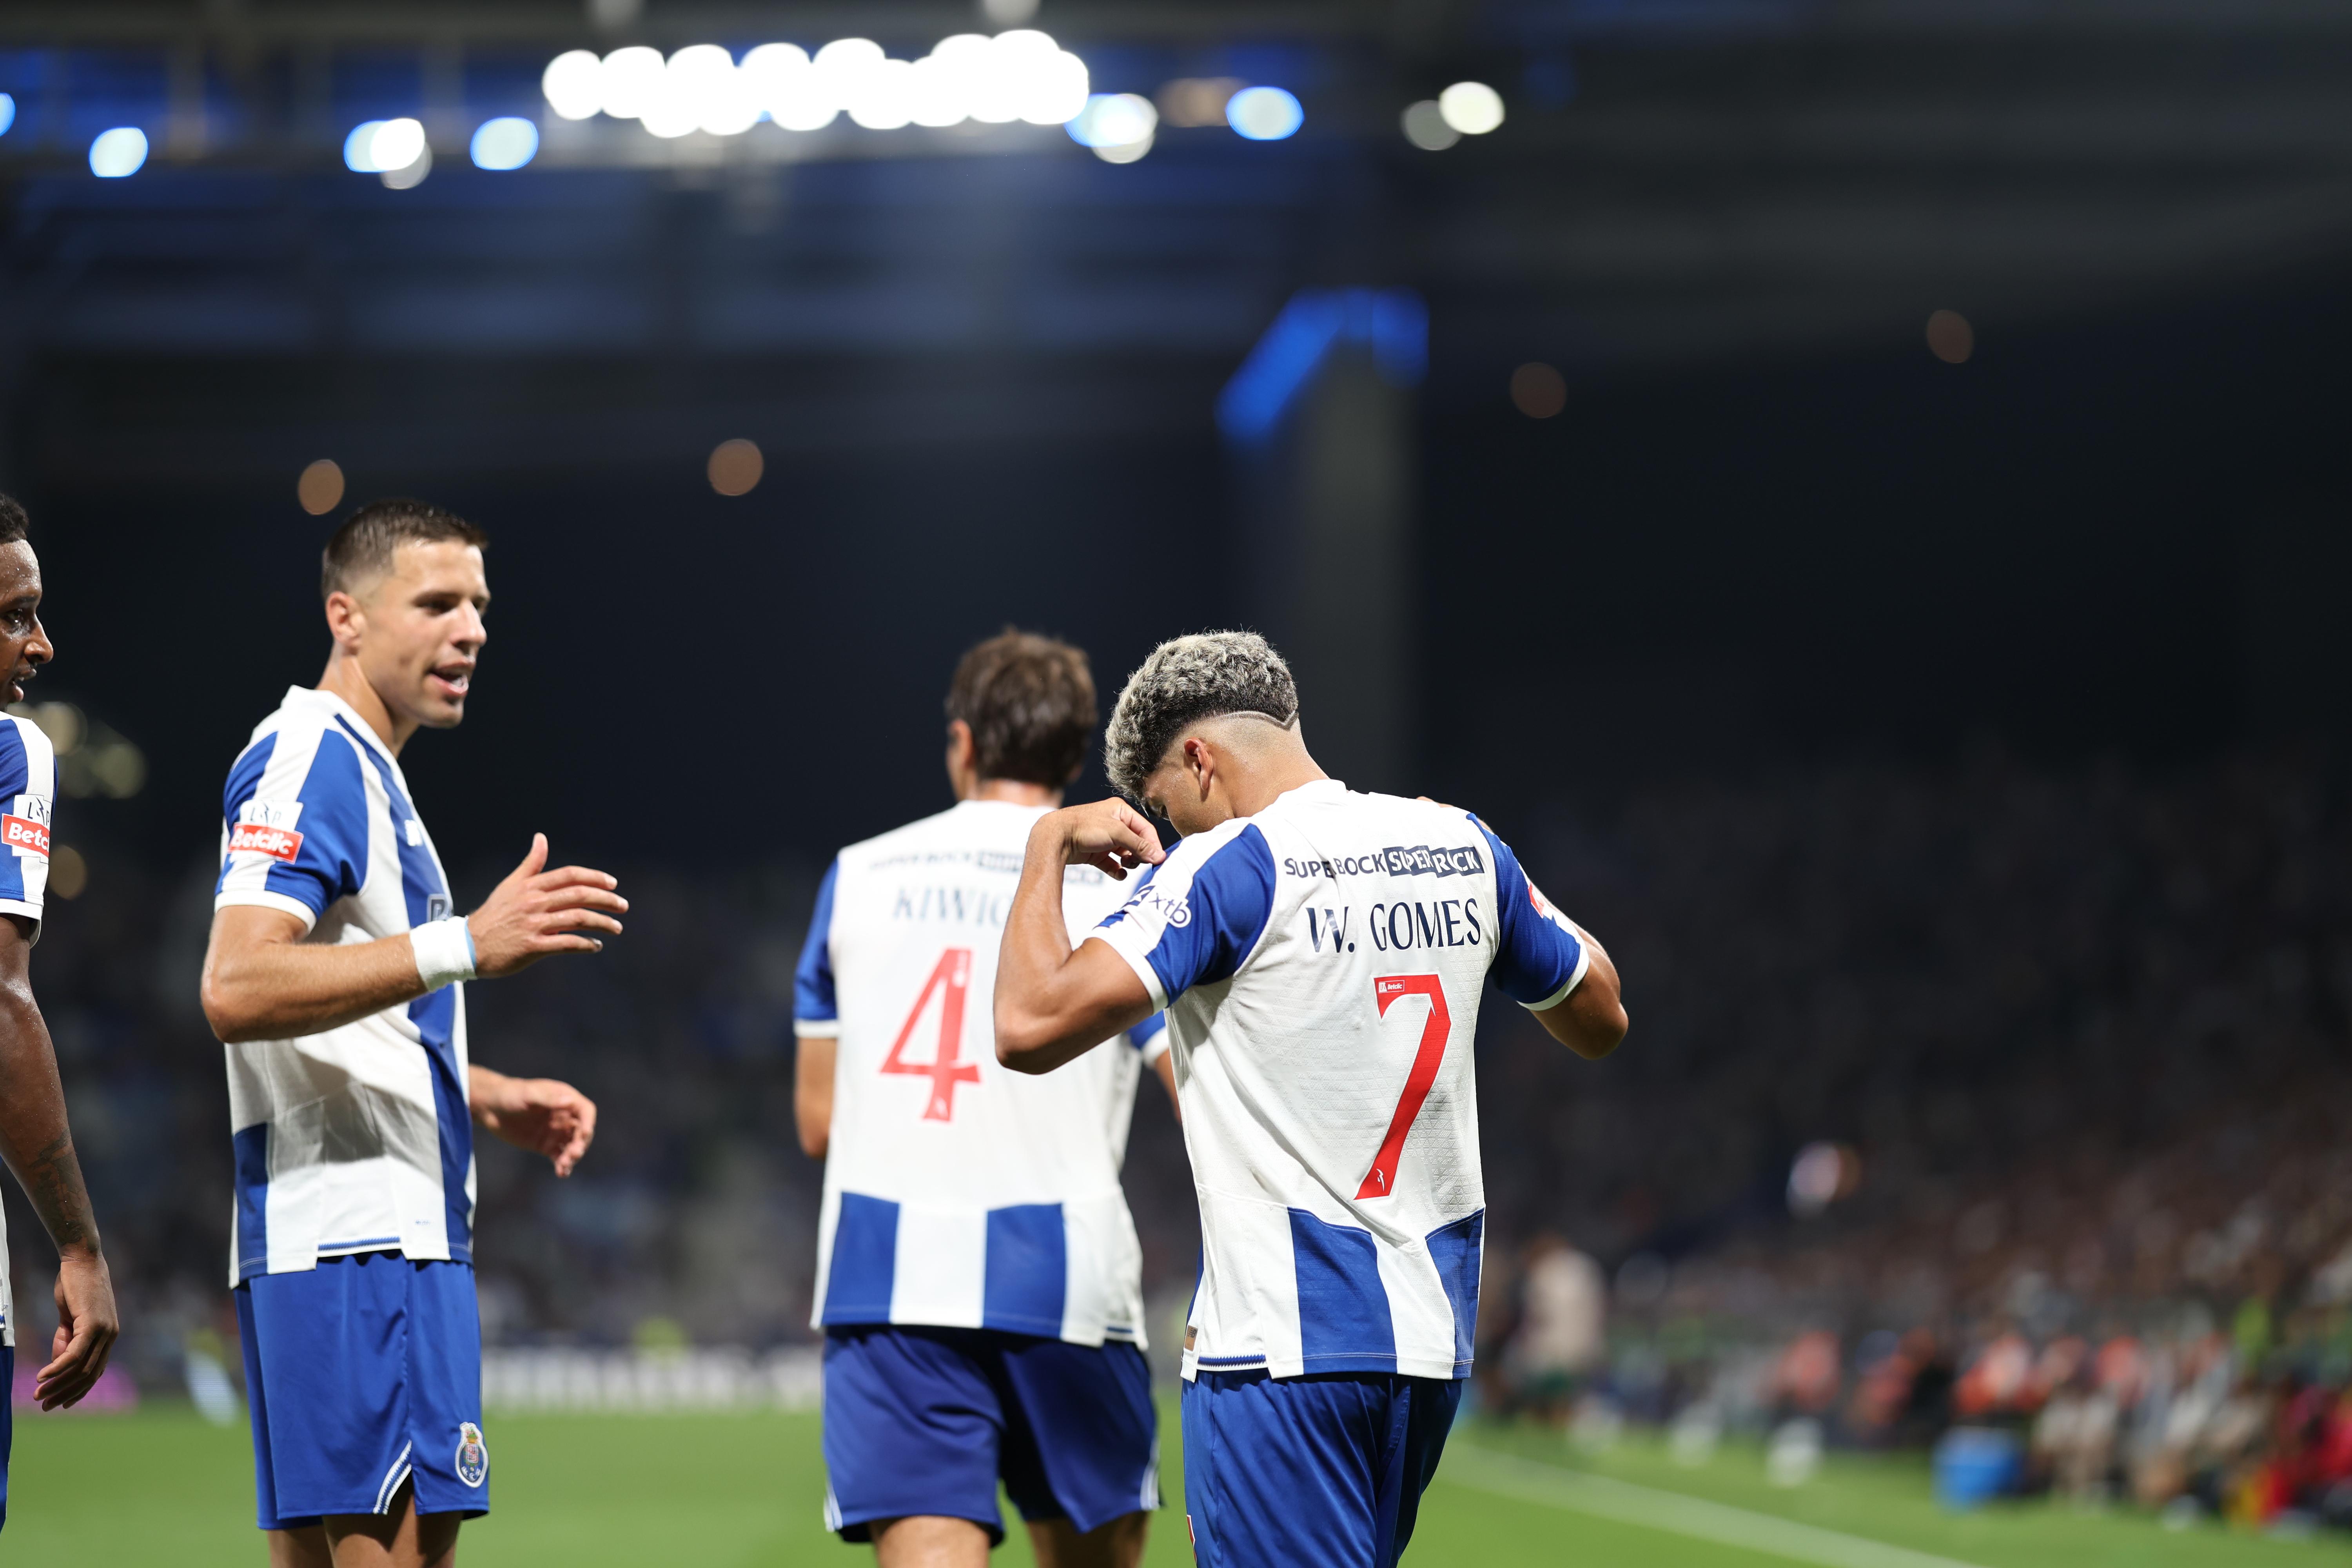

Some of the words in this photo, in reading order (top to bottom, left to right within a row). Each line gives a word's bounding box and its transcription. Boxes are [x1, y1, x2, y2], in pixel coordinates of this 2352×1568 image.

[230, 828, 294, 855] Betclic
[1284, 858, 1337, 878] SUPE
[1149, 892, 1187, 924] xtb
[1305, 906, 1355, 953] W.
[1370, 898, 1481, 952] GOMES
[878, 948, 982, 1123] 4
[1353, 974, 1452, 1200] 7
